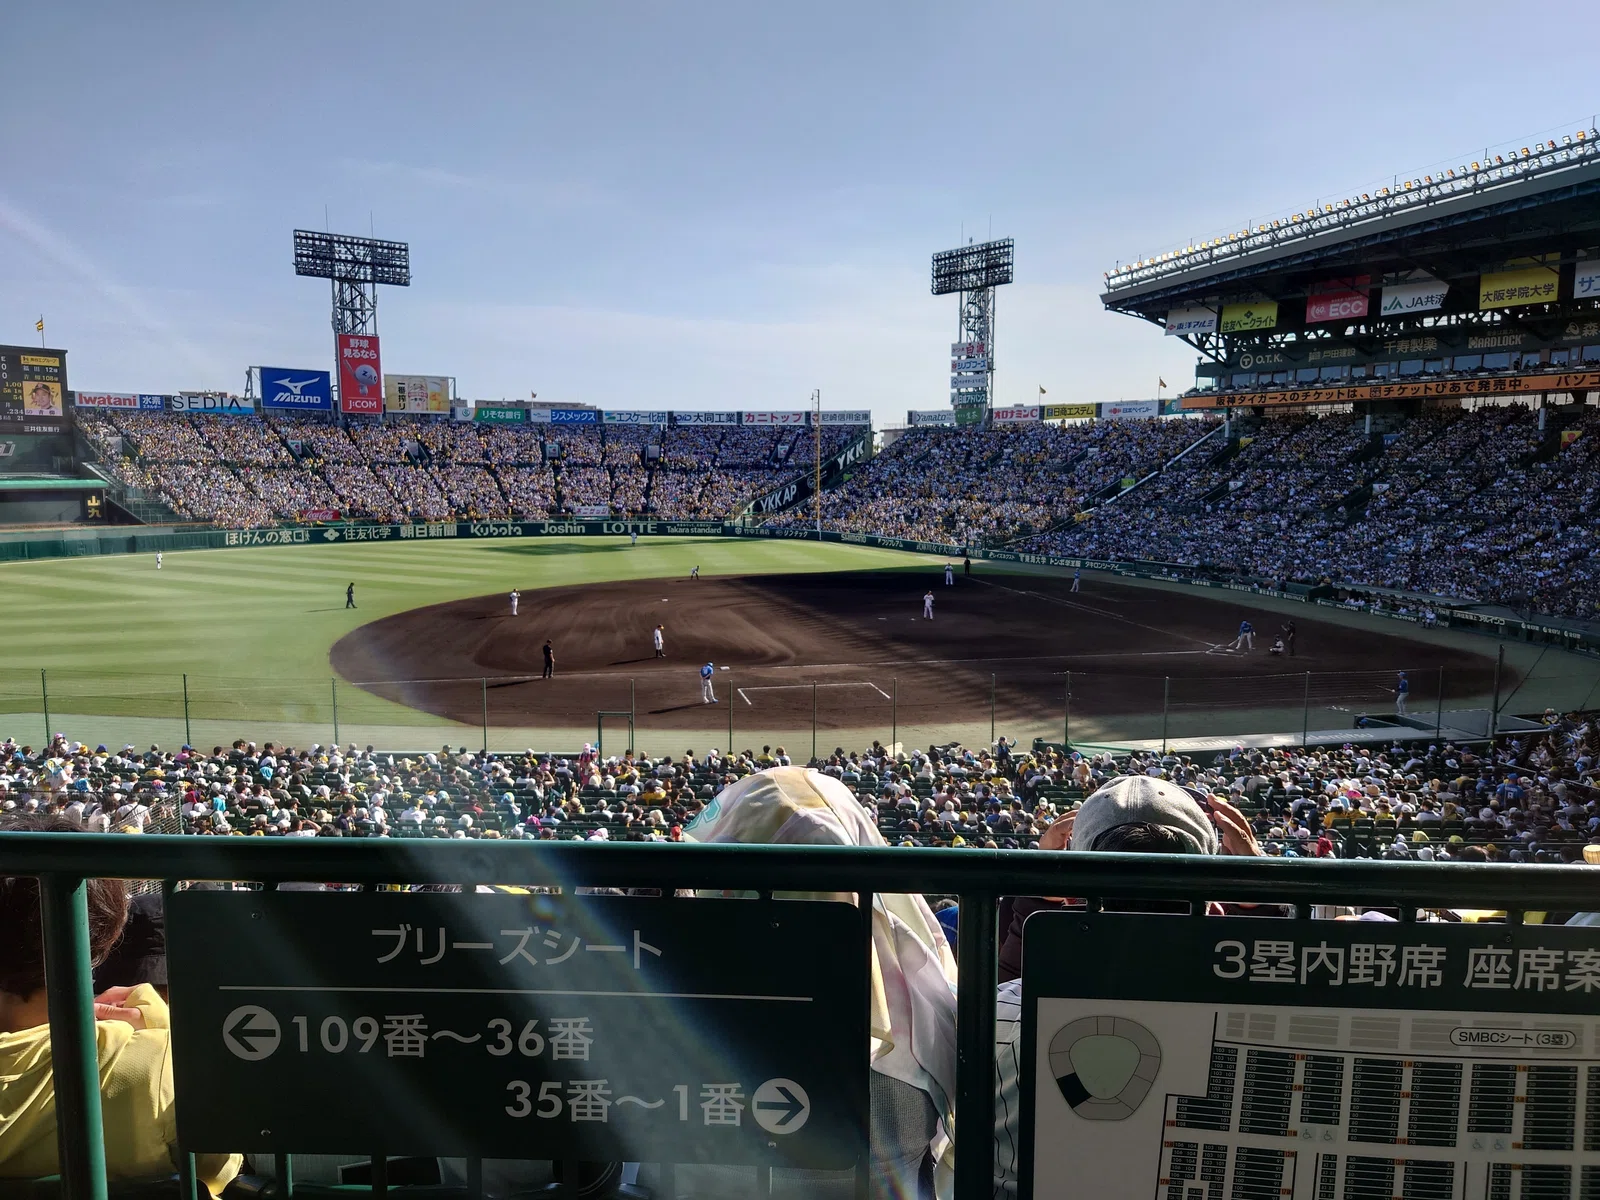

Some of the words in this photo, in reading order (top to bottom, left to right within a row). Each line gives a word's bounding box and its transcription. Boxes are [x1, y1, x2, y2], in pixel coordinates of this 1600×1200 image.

[1482, 283, 1555, 303] 大阪学院大学
[1329, 300, 1363, 317] ECC
[1176, 319, 1214, 330] 東洋アルミ
[1222, 316, 1274, 332] 住友ベークライト
[350, 338, 369, 348] 野球
[966, 342, 985, 354] 白波
[1383, 337, 1438, 355] 千寿製薬
[344, 349, 377, 359] 見るなら
[1256, 353, 1283, 364] O.T.K.
[1322, 348, 1356, 359] 戸田建設
[273, 392, 321, 404] MIZUNO
[398, 382, 406, 410] 一番搾り
[1216, 389, 1364, 406] 阪神タイガースのチケットは、
[1384, 378, 1529, 396] チケットぴあで発売中。
[78, 393, 137, 406] Iwatani
[143, 396, 161, 405] 水素
[172, 396, 242, 411] SEDIA
[349, 400, 377, 409] J:COM
[482, 411, 521, 420] りそな銀行
[552, 412, 595, 421] シスメックス
[616, 412, 666, 422] エスケー化研
[822, 413, 869, 422] 尼崎信用金庫
[916, 413, 946, 422] Yamato
[994, 408, 1038, 420] オロナミンC
[1054, 406, 1094, 417] 日商エステム
[693, 413, 735, 423] 大同工業
[745, 413, 803, 423] カニトップ
[837, 440, 864, 470] YKK
[760, 492, 782, 513] YKK
[782, 484, 797, 504] AP
[87, 495, 102, 518] 山九
[343, 527, 391, 540] 住友化学
[400, 524, 457, 538] 朝日新聞
[471, 524, 522, 536] Kubota
[540, 523, 585, 534] Joshin
[603, 522, 657, 534] LOTTE
[225, 530, 304, 546] ほけんの窓口
[841, 534, 866, 544] SHIMANO
[1025, 555, 1046, 564] 東海大学
[1050, 558, 1081, 567] トンボ学生服
[371, 924, 662, 969] ブリーズシート
[1213, 940, 1447, 987] 3塁内野席
[1463, 946, 1600, 992] 座席案
[291, 1012, 594, 1062] 109番〜36番
[505, 1078, 746, 1126] 35番〜1番
